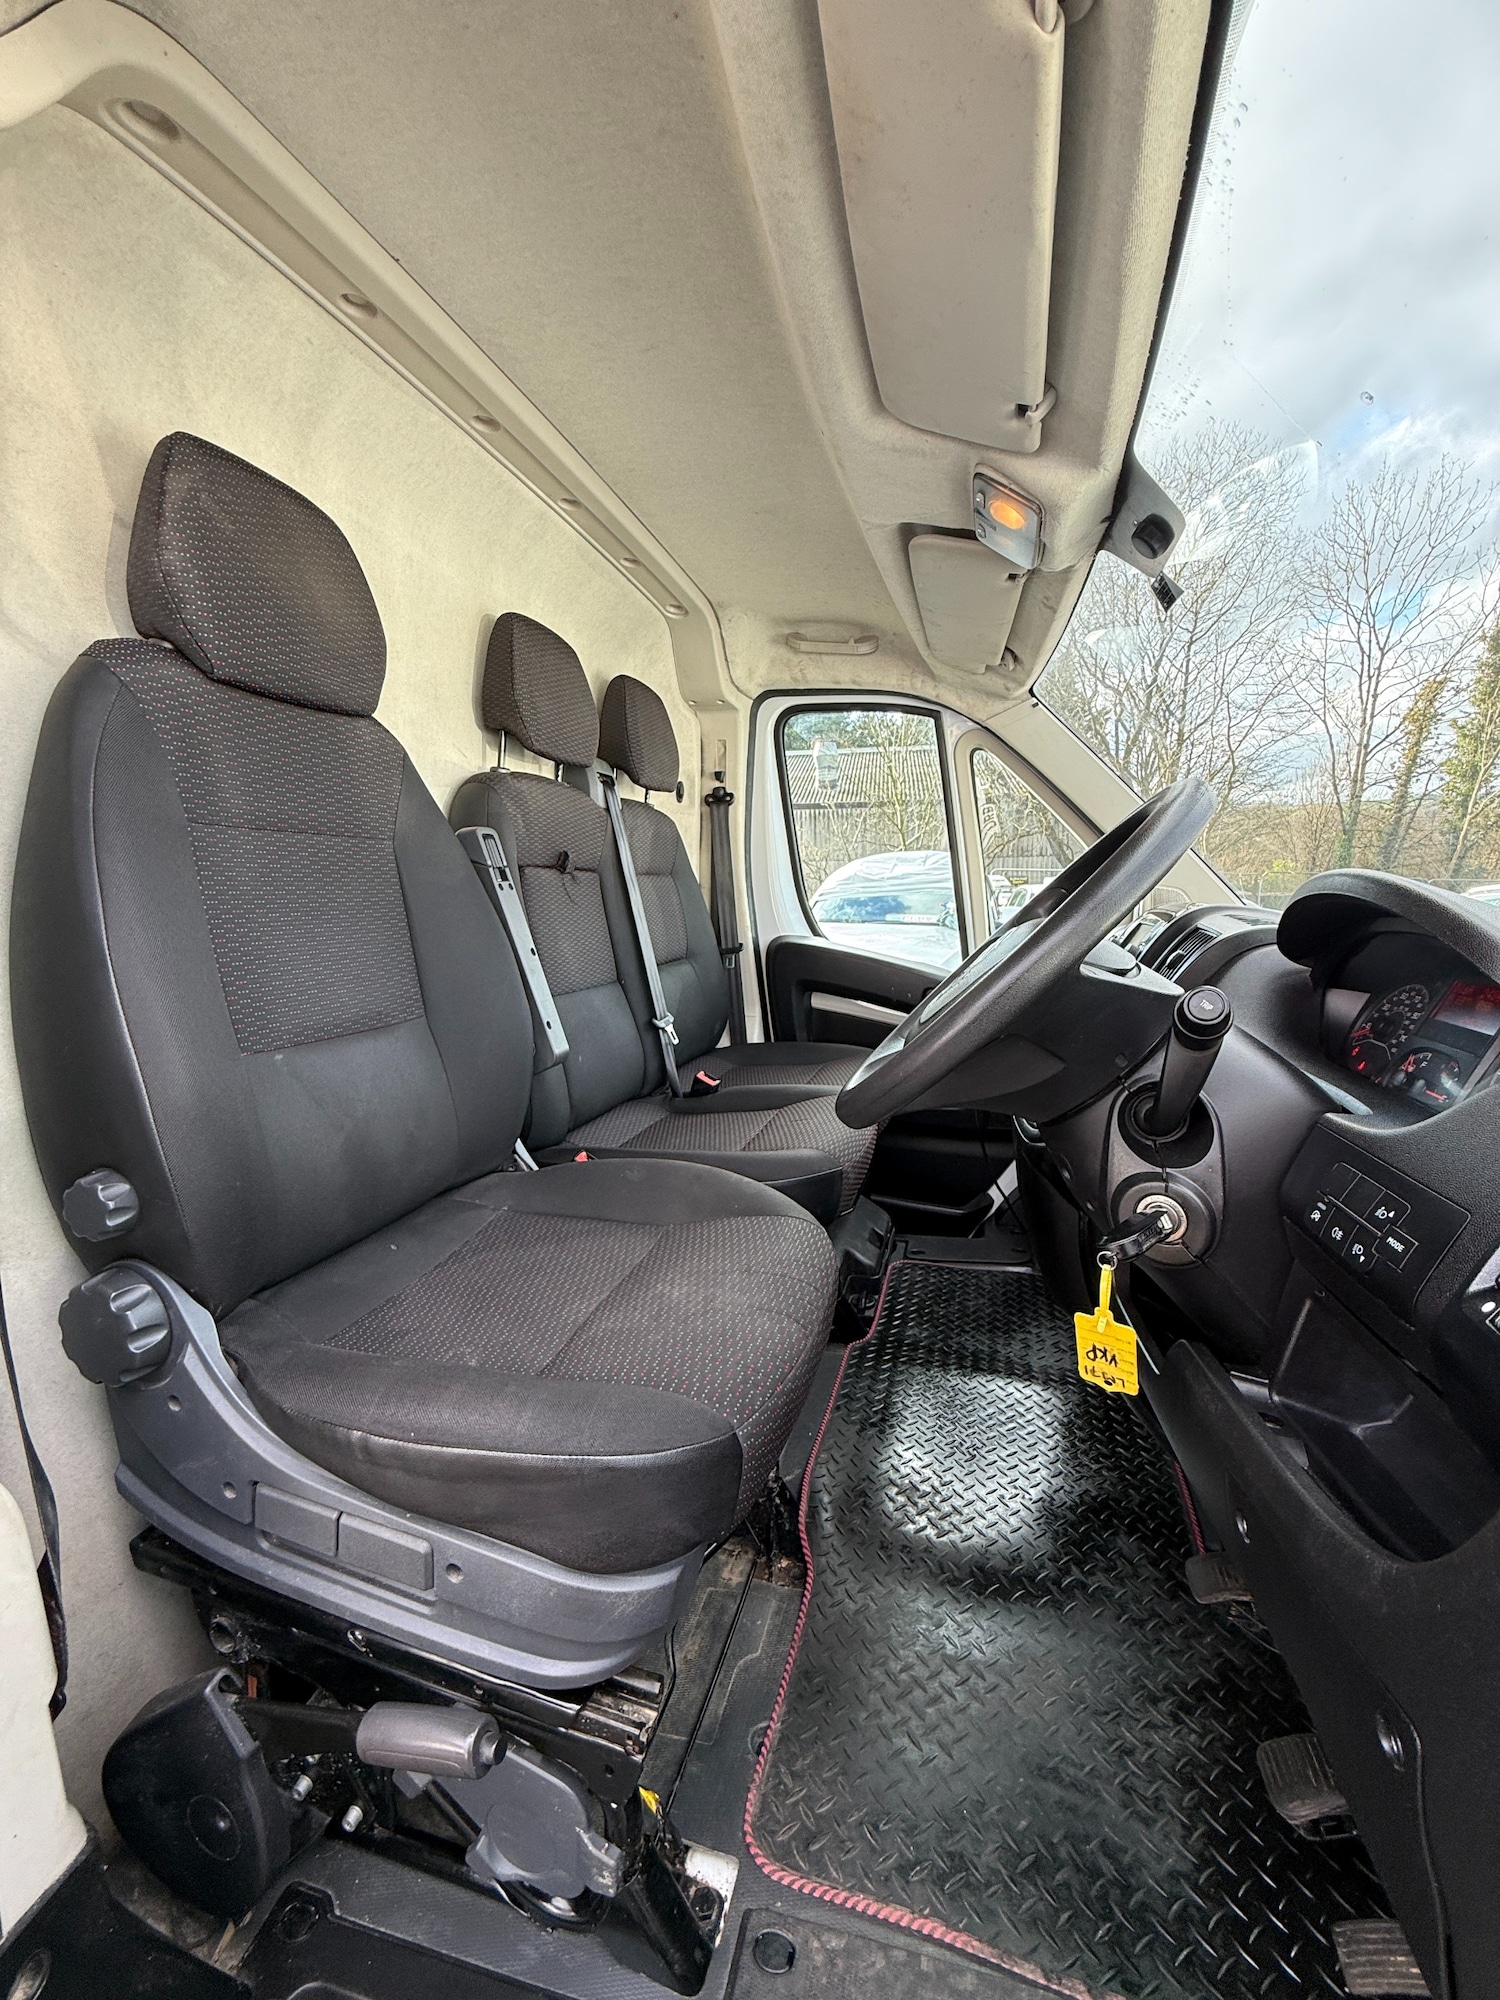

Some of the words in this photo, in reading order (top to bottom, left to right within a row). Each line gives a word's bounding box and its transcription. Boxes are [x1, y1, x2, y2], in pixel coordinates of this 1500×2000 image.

[1199, 999, 1214, 1011] TRIP
[1386, 1236, 1405, 1253] MODE
[1085, 1343, 1118, 1368] VKP
